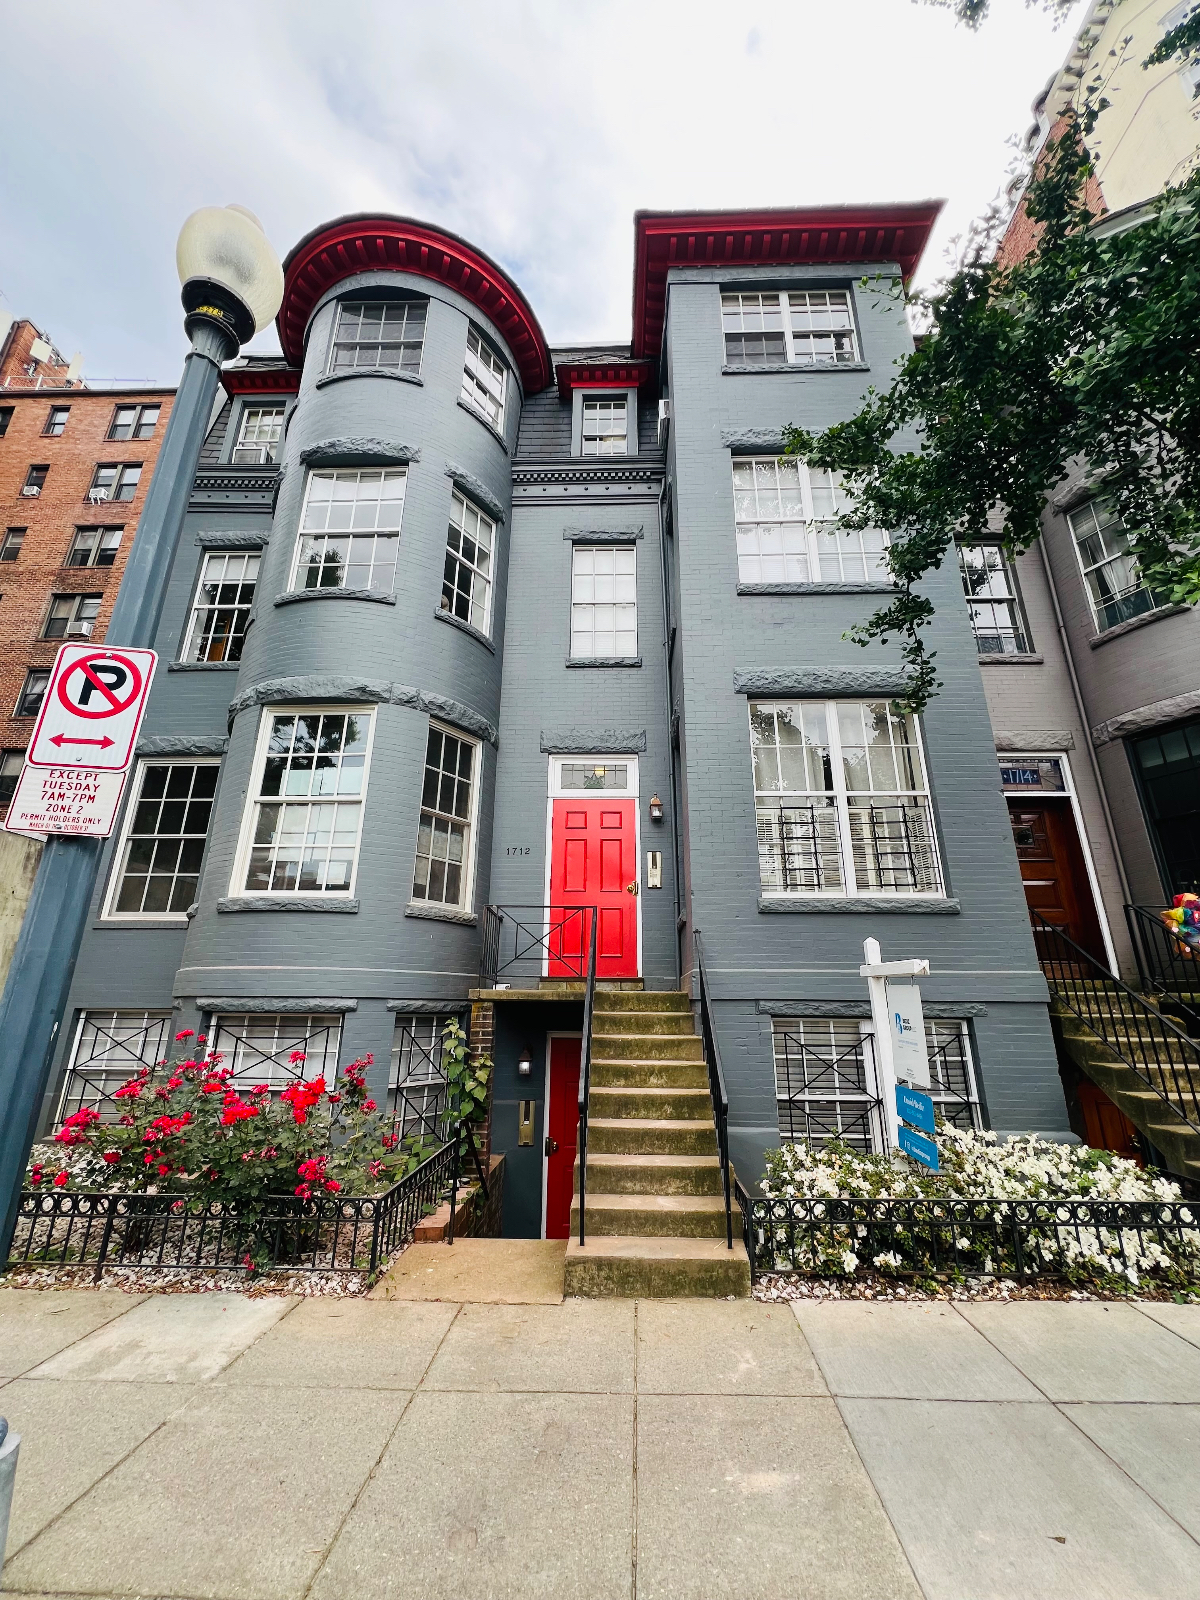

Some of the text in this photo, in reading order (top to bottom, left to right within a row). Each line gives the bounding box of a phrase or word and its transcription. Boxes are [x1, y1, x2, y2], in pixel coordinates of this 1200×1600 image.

[78, 663, 127, 706] P
[49, 770, 100, 782] EXCEPT
[1009, 769, 1032, 783] 1714
[42, 780, 101, 793] TUESDAY
[41, 791, 96, 804] 7AM-7PM
[46, 803, 84, 815] ZONE 2
[20, 812, 102, 825] PERMIT HOLDERS ONLY
[506, 847, 531, 856] 1712
